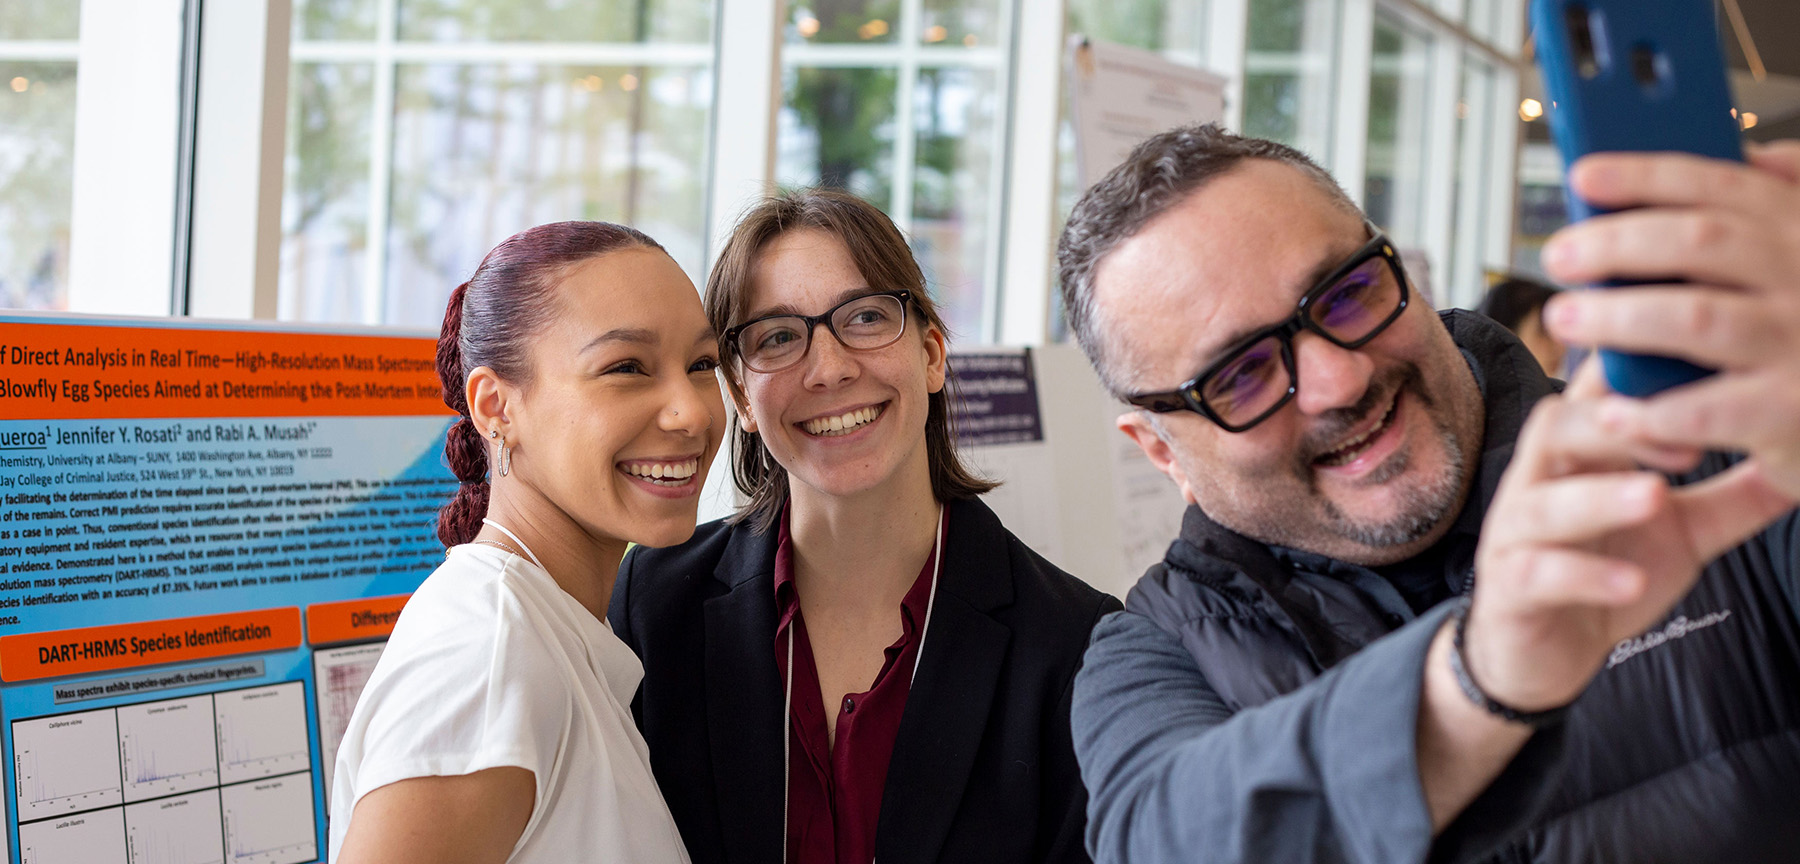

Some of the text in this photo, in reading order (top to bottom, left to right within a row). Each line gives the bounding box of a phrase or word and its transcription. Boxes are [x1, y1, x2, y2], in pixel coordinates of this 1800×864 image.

[11, 346, 59, 366] Direct
[64, 347, 127, 370] Analysis
[132, 348, 145, 366] in
[150, 349, 181, 367] Real
[343, 354, 374, 370] Mass
[0, 378, 57, 402] Blowfly
[62, 379, 90, 402] Egg
[93, 380, 150, 402] Species
[154, 380, 201, 399] Aimed
[205, 382, 219, 398] at
[223, 382, 309, 402] Determining
[311, 383, 333, 399] the
[336, 384, 414, 400] Post-Mortem
[0, 425, 51, 447] ueroa¹
[56, 426, 115, 445] Jennifer
[118, 427, 131, 443] Y.
[187, 425, 212, 442] and
[215, 425, 244, 442] Rabi
[247, 425, 261, 441] A.
[47, 453, 93, 467] University
[95, 455, 105, 465] at
[107, 452, 137, 466] Albany
[146, 451, 172, 465] SUNY,
[198, 450, 245, 463] Washington
[247, 449, 264, 461] Ave,
[266, 448, 295, 461] Albany,
[297, 448, 308, 458] NY
[0, 475, 15, 489] Jay
[18, 471, 52, 488] College
[54, 471, 64, 484] of
[66, 470, 105, 484] Criminal
[107, 470, 138, 483] Justice,
[140, 470, 156, 481] 524
[157, 469, 180, 481] West
[214, 467, 233, 478] New
[236, 466, 254, 478] York,
[256, 466, 268, 475] NY
[5, 493, 51, 505] facilitating
[53, 491, 67, 502] the
[69, 488, 128, 502] determination
[130, 488, 139, 499] of
[140, 487, 153, 498] the
[155, 487, 173, 498] time
[175, 485, 203, 499] elapsed
[206, 485, 225, 496] since
[227, 483, 249, 496] death,
[3, 510, 13, 522] of
[14, 510, 30, 522] the
[31, 508, 68, 520] remains.
[69, 507, 100, 519] Correct
[101, 506, 119, 517] PMI
[120, 504, 160, 518] prediction
[161, 502, 193, 515] requires
[194, 501, 225, 512] accurate
[227, 498, 273, 511] identification
[1, 529, 10, 540] as
[13, 529, 20, 539] a
[22, 527, 42, 539] case
[44, 526, 53, 537] in
[55, 524, 80, 539] point.
[82, 522, 105, 535] Thus,
[107, 519, 159, 533] conventional
[161, 519, 189, 532] species
[191, 516, 240, 529] identification
[25, 542, 72, 557] equipment
[74, 539, 90, 552] and
[92, 537, 127, 551] resident
[128, 536, 167, 549] expertise,
[169, 533, 192, 545] which
[245, 529, 260, 541] that
[12, 560, 54, 574] evidence.
[56, 554, 115, 570] Demonstrated
[117, 553, 136, 566] here
[139, 552, 145, 564] is
[148, 554, 154, 563] a
[156, 549, 186, 562] method
[188, 548, 204, 560] that
[206, 546, 235, 559] enables
[237, 545, 249, 557] the
[251, 544, 279, 556] prompt
[0, 578, 32, 592] olution
[33, 578, 56, 589] mass
[58, 572, 113, 589] spectrometry
[173, 565, 188, 577] The
[22, 592, 79, 607] identification
[80, 588, 101, 602] with
[102, 590, 113, 600] an
[115, 586, 150, 599] accuracy
[151, 583, 160, 595] of
[194, 579, 219, 592] Future
[220, 577, 239, 589] work
[0, 615, 21, 626] ence.
[38, 623, 271, 666] DART-HRMS Species Identification
[55, 688, 76, 701] Mass
[76, 685, 104, 700] spectra
[105, 679, 131, 693] exhibit
[131, 673, 185, 692] species-specific
[186, 668, 217, 683] chemical
